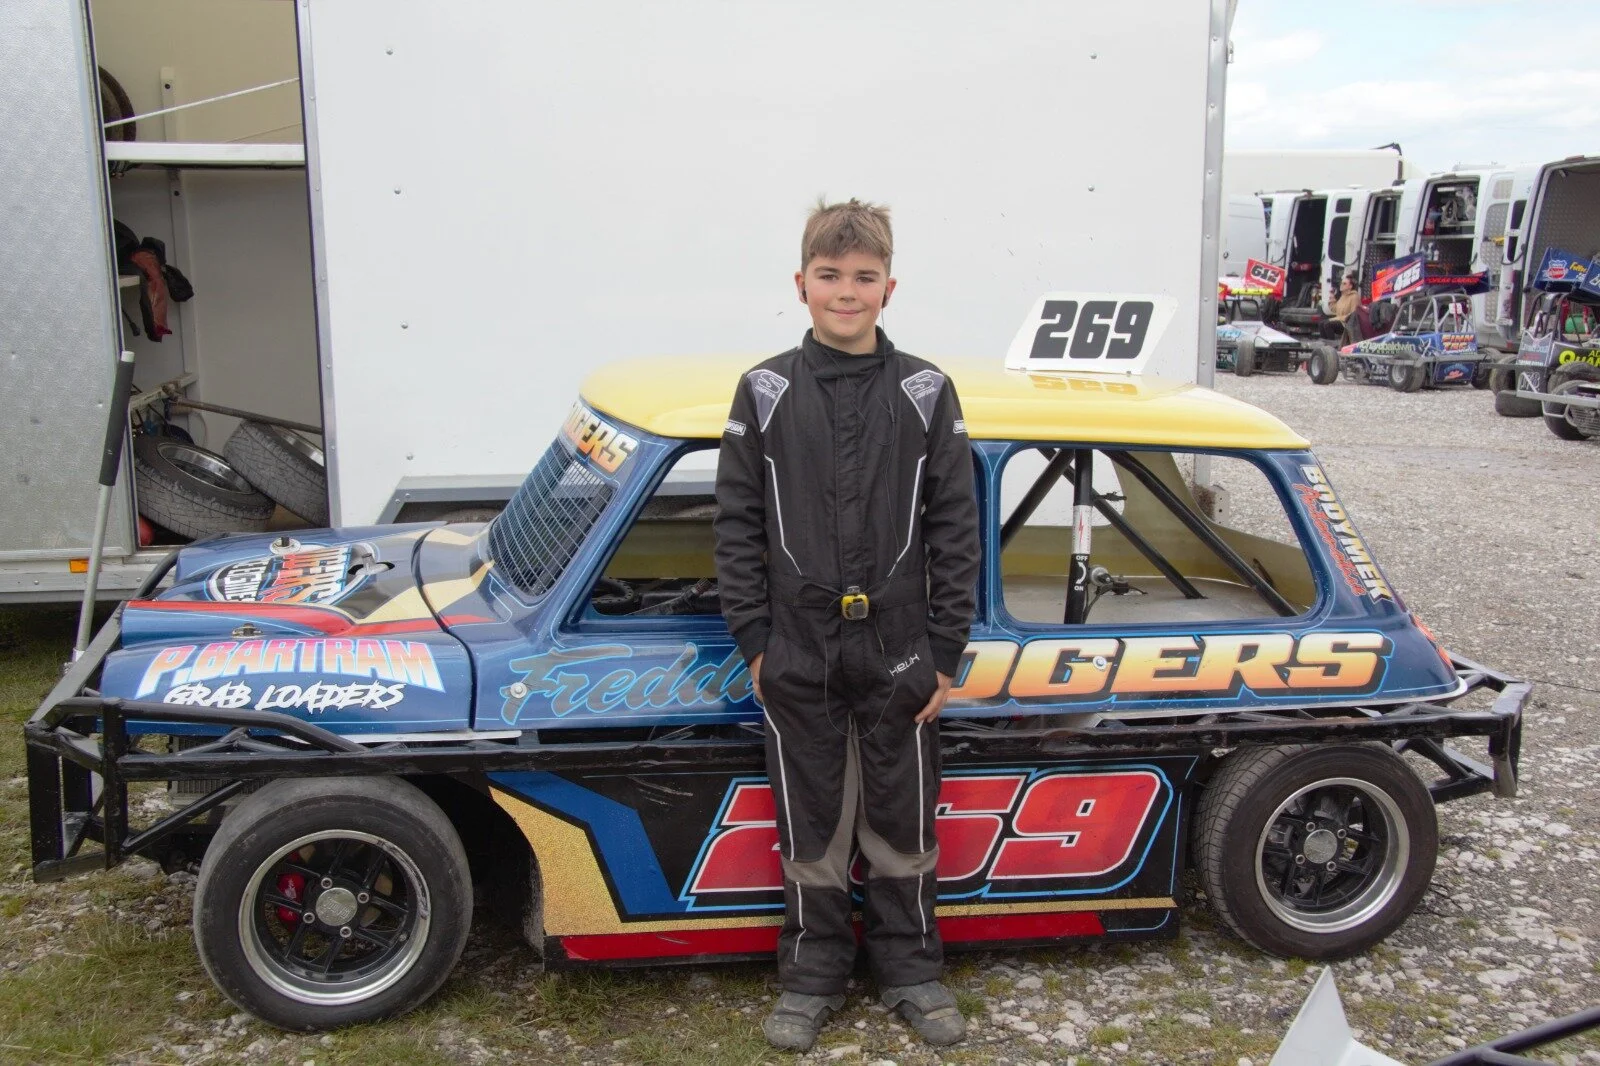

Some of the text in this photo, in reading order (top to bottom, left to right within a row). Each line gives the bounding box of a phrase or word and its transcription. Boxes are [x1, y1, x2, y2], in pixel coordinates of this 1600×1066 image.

[1029, 300, 1155, 359] 269
[945, 633, 1386, 699] OGERS
[163, 680, 407, 714] GRAB LOADERS
